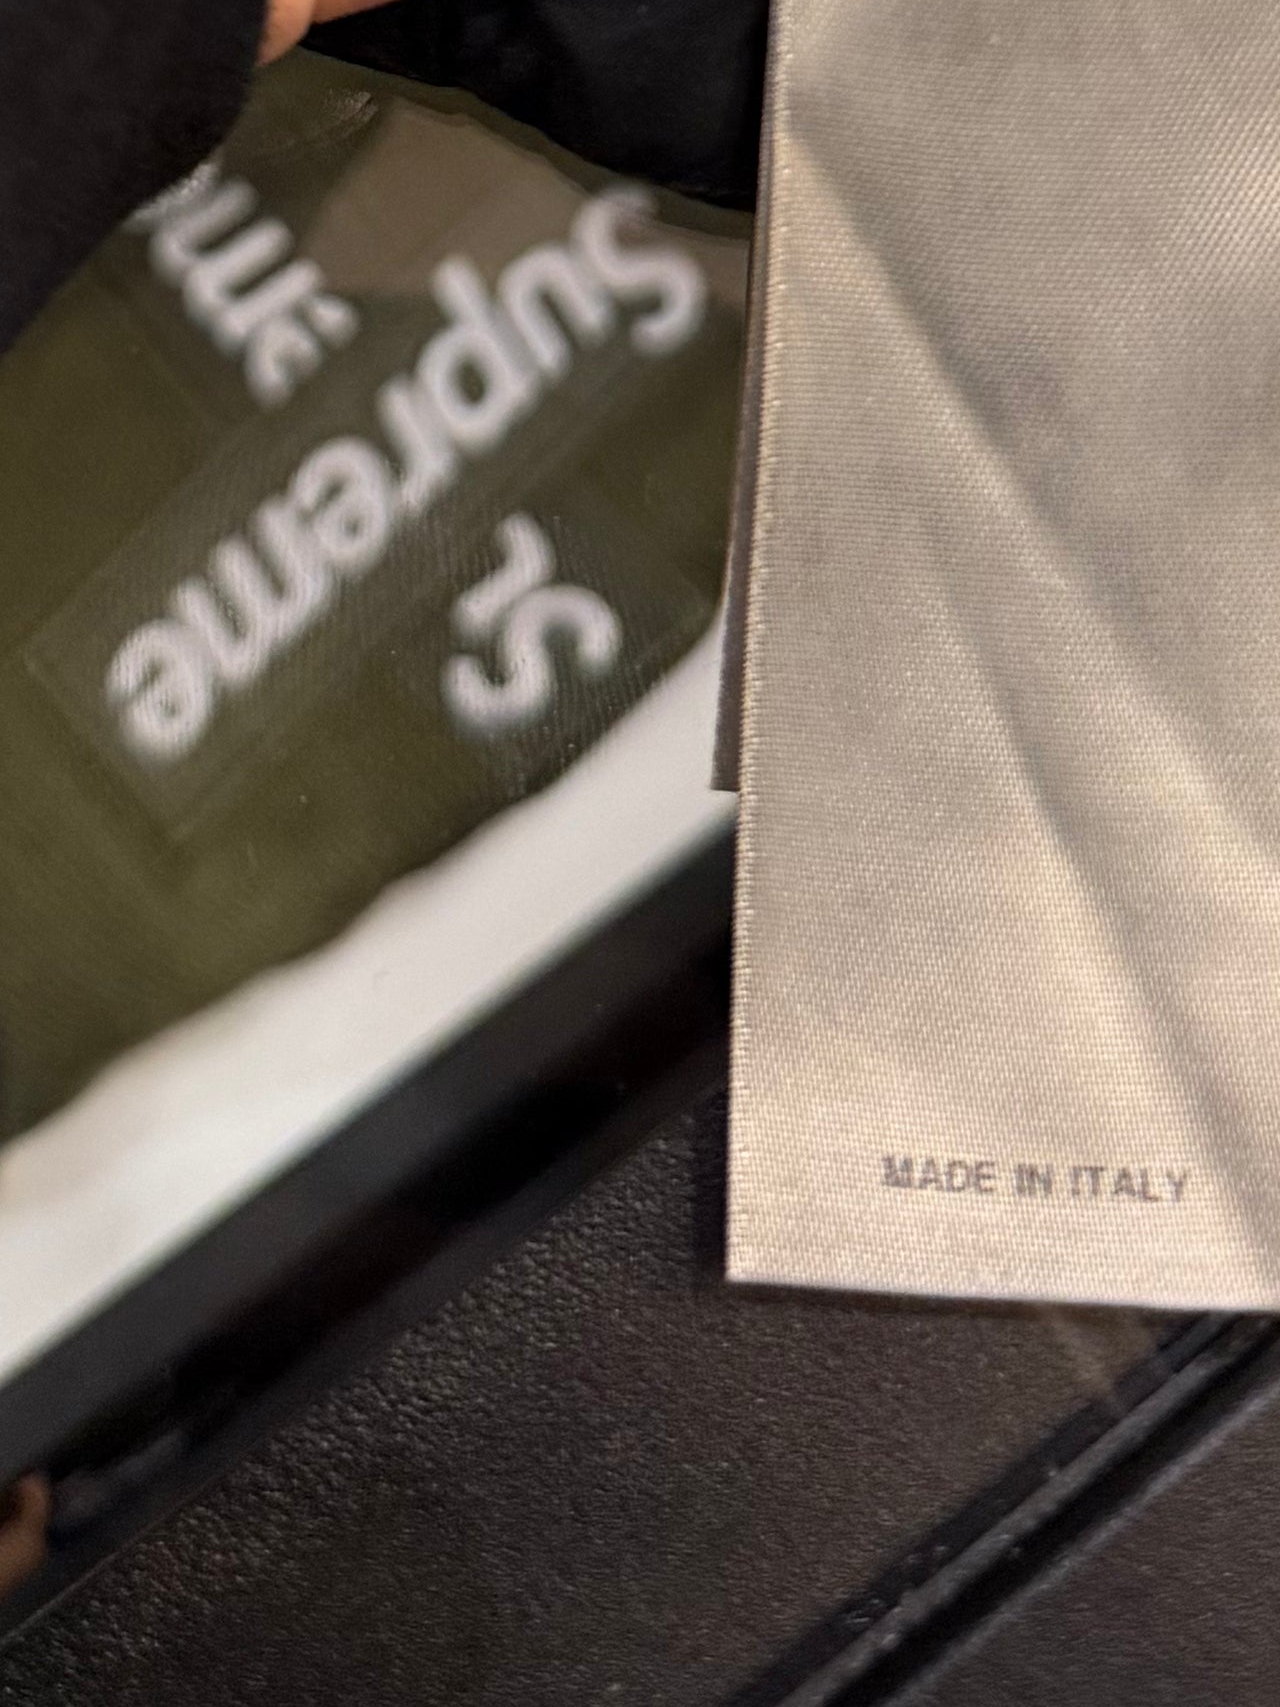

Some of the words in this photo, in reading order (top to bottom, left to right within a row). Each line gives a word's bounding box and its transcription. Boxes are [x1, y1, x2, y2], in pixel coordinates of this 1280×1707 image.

[108, 185, 708, 767] Supreme
[881, 1155, 995, 1195] MADE
[1016, 1164, 1053, 1198] IN
[1070, 1164, 1187, 1202] ITALY
